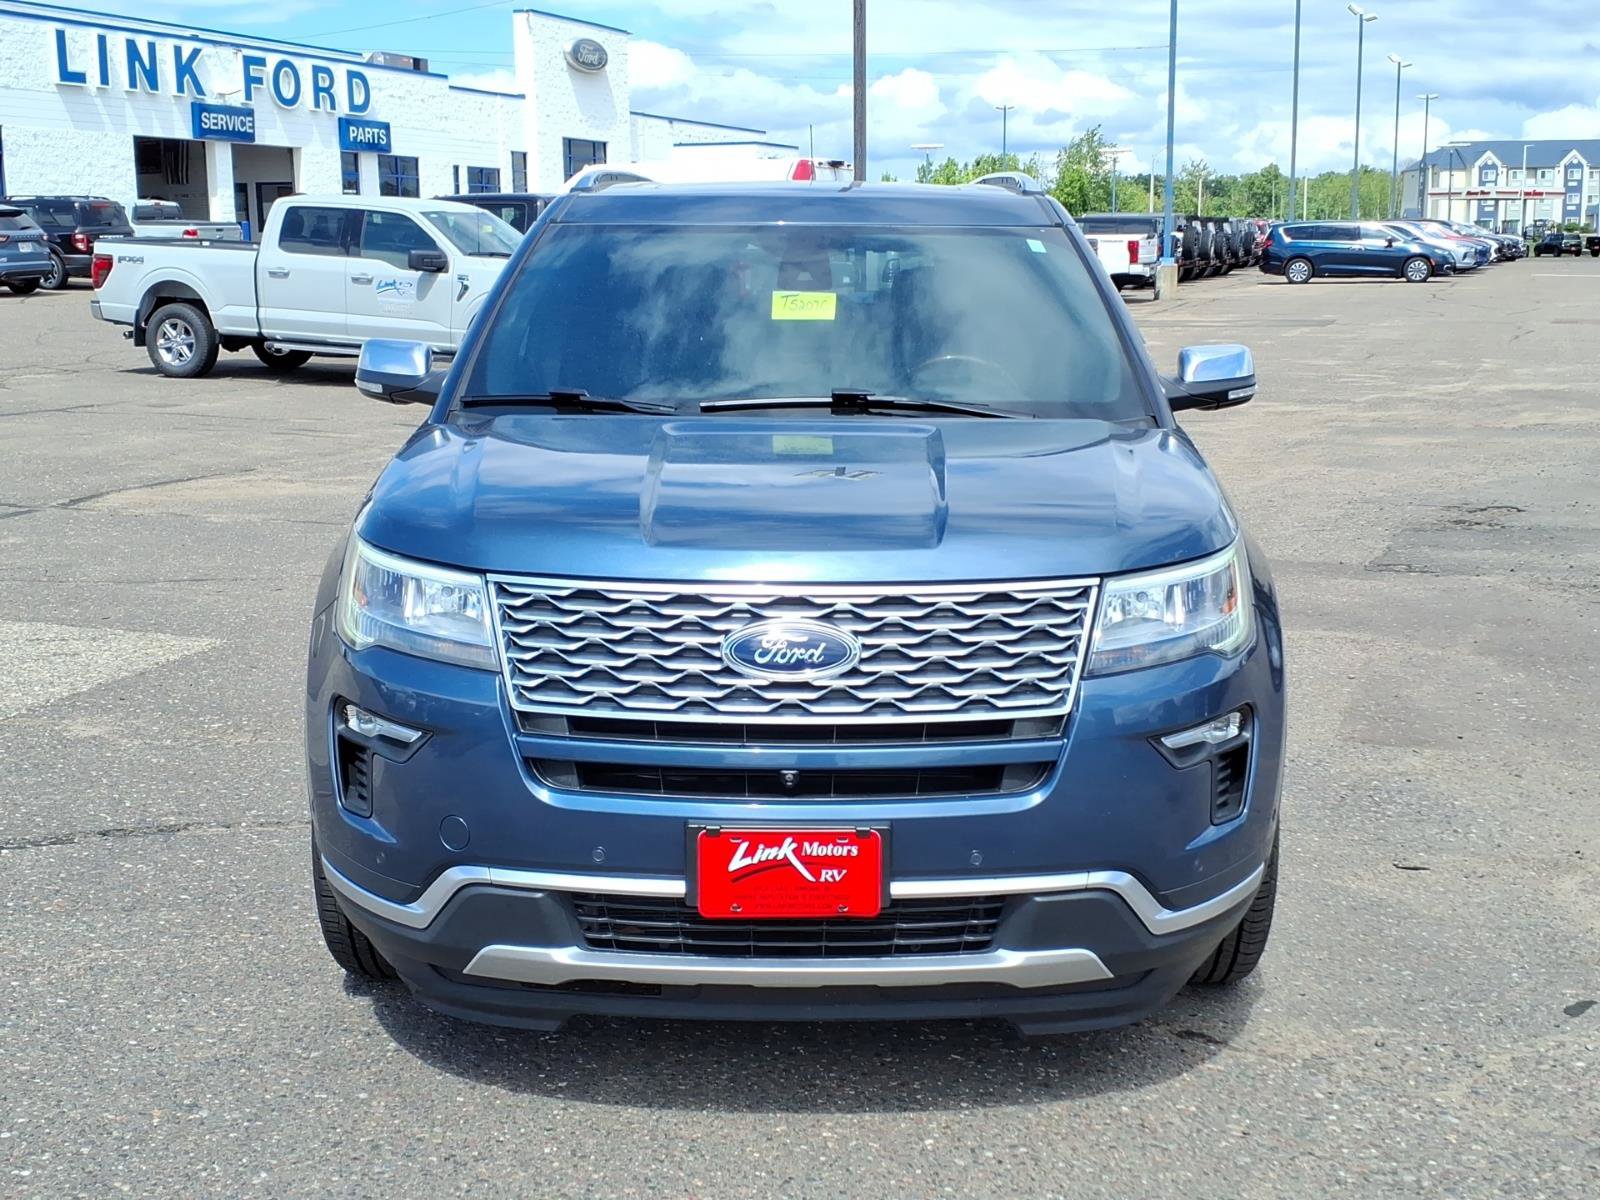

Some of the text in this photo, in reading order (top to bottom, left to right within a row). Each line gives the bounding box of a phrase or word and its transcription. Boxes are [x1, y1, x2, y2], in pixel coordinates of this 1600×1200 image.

[55, 28, 371, 115] LINK FORD
[200, 111, 255, 133] SERVICE
[349, 126, 387, 144] PARTS
[753, 627, 827, 664] Ford
[727, 836, 859, 883] Link Motors
[819, 868, 848, 883] RV
